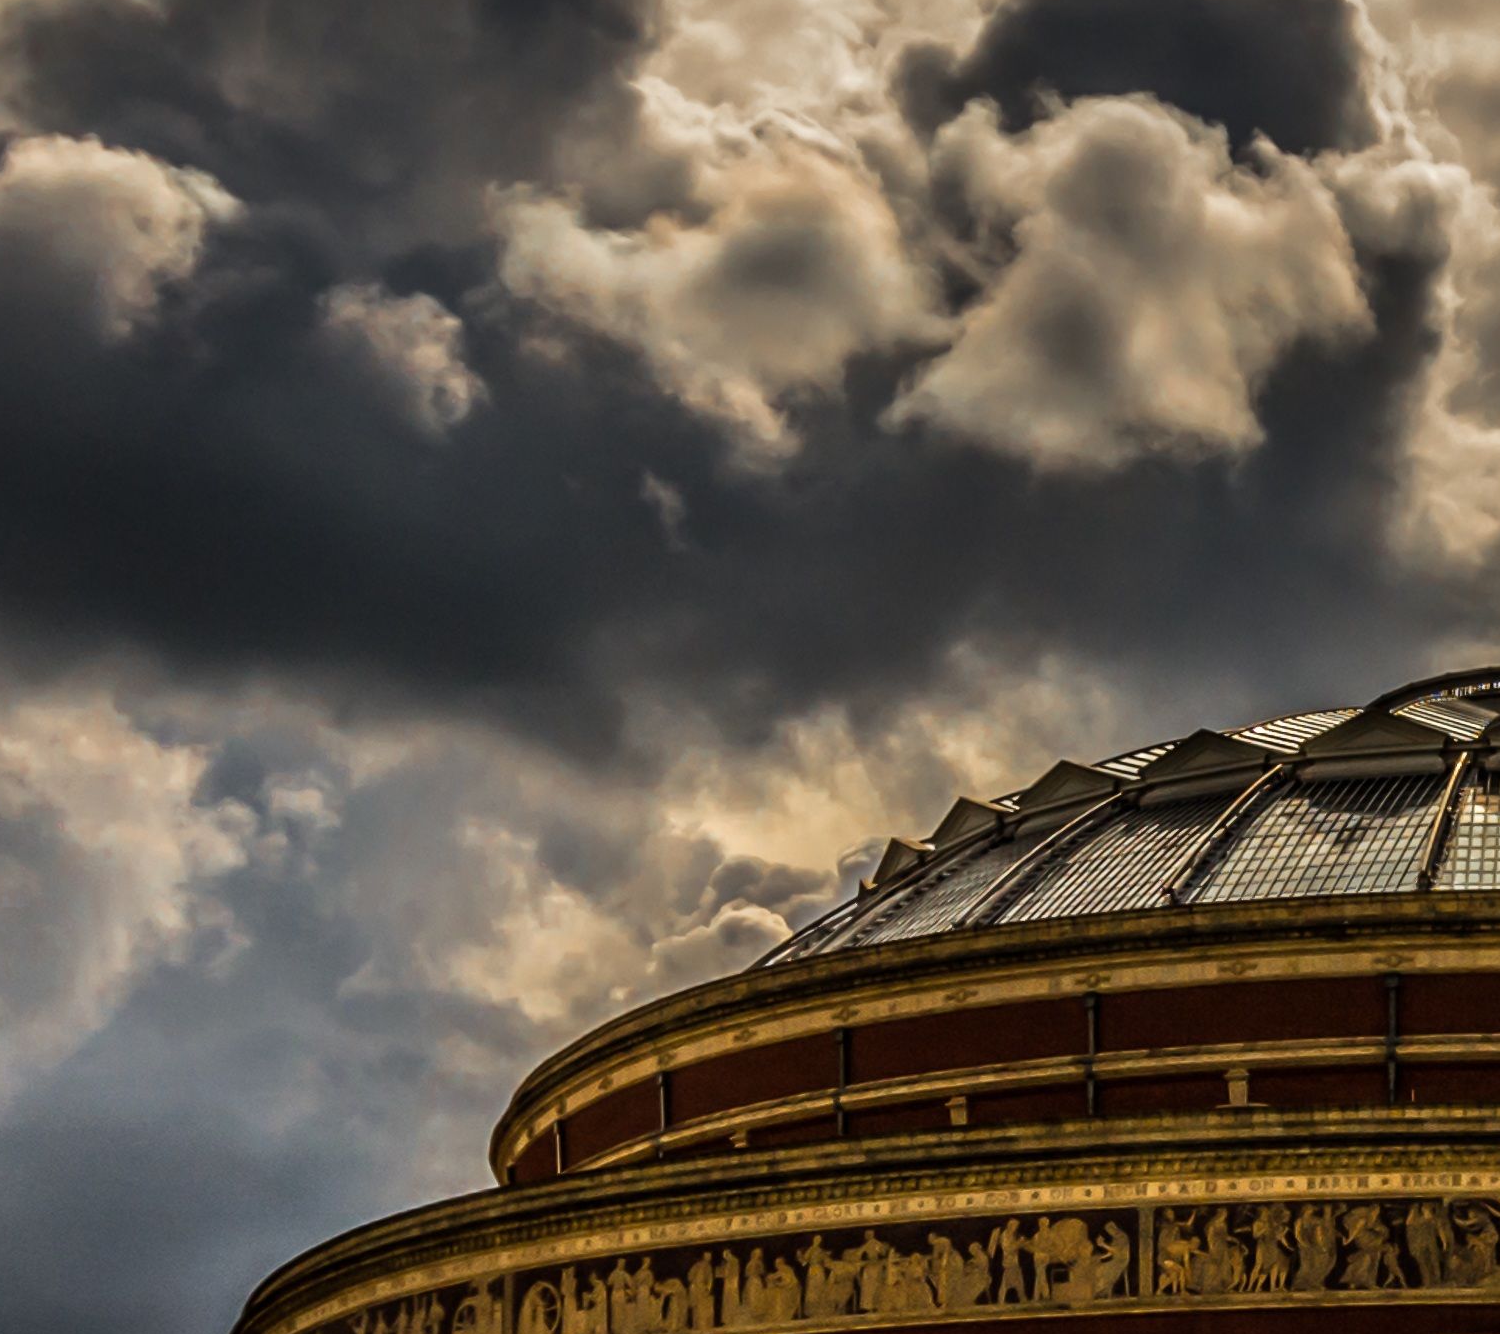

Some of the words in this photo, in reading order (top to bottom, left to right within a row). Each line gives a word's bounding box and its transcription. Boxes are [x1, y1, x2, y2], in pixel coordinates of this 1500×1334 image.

[937, 1194, 957, 1209] TO
[1306, 1177, 1369, 1191] EARTH
[1400, 1174, 1463, 1189] PEACE
